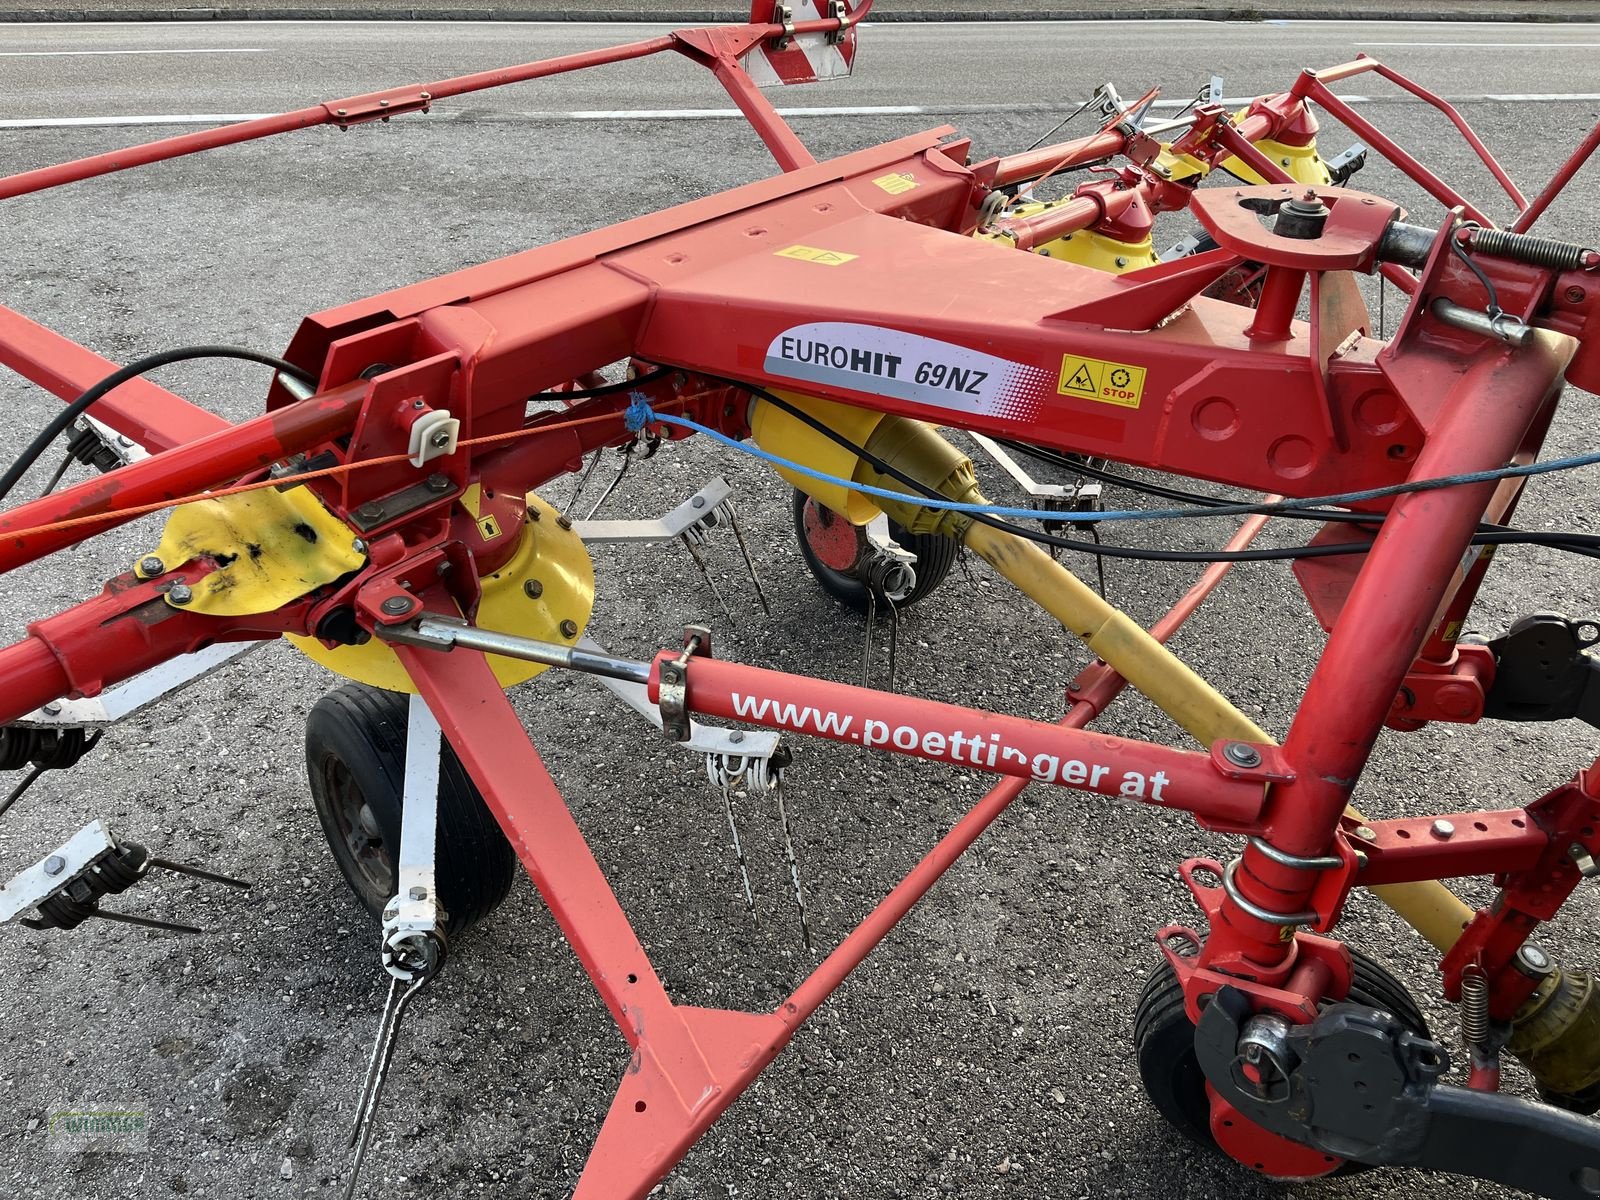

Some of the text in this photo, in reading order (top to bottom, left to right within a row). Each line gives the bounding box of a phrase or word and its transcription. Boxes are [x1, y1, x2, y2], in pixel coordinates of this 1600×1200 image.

[780, 336, 989, 396] EUROHIT 69NZ
[1102, 386, 1136, 400] STOP
